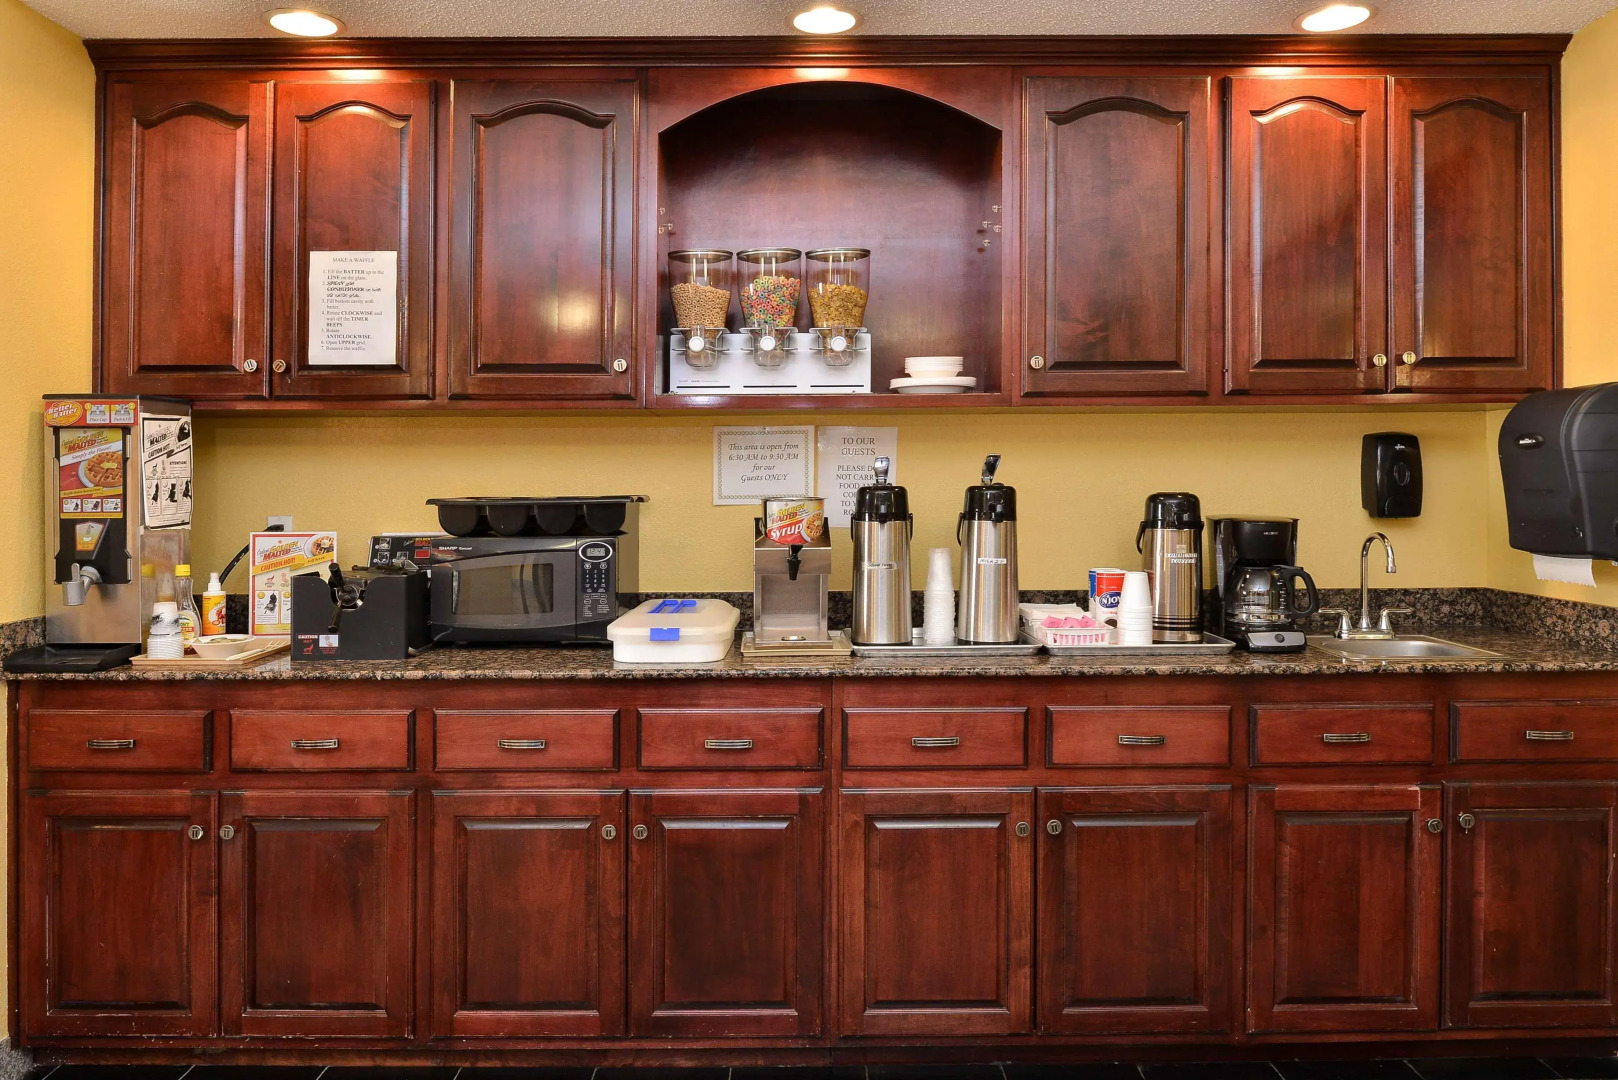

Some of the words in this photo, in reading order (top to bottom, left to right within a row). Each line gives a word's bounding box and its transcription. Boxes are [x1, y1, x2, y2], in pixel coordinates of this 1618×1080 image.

[68, 440, 96, 452] MALTED
[728, 442, 742, 450] This
[782, 442, 799, 452] from
[744, 453, 759, 461] AM
[784, 452, 800, 460] AM
[842, 448, 876, 456] GUESTS
[751, 463, 764, 473] for
[740, 474, 764, 484] Guests
[764, 472, 789, 481] ONLY
[770, 522, 804, 541] Syrup
[260, 561, 282, 572] CAUTION
